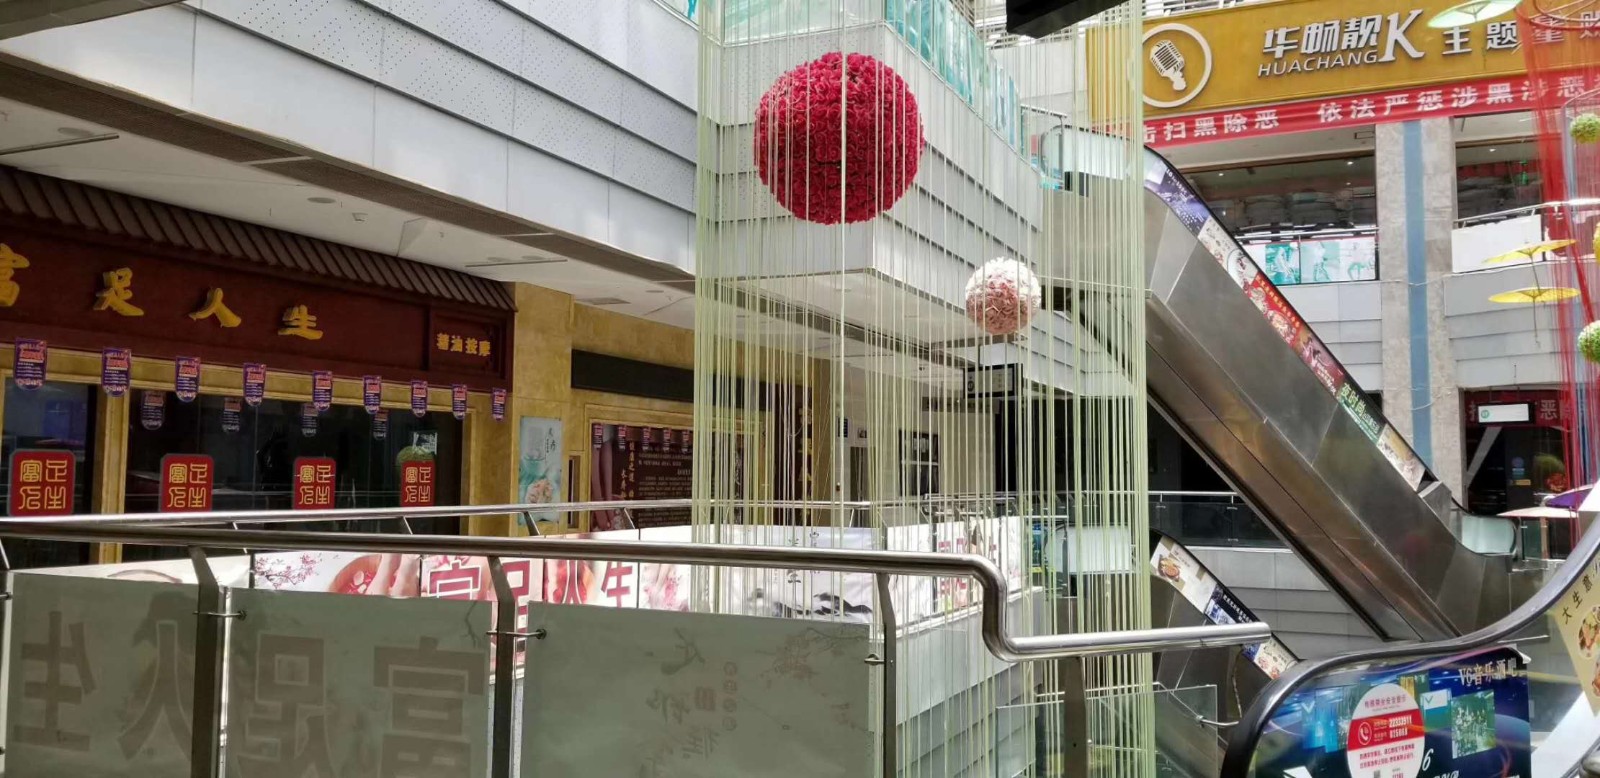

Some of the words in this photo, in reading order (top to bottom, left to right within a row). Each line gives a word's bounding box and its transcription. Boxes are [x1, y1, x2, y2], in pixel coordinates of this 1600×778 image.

[1258, 50, 1379, 77] HUACHANG
[1317, 73, 1600, 123] 依法严惩涉黑涉恶
